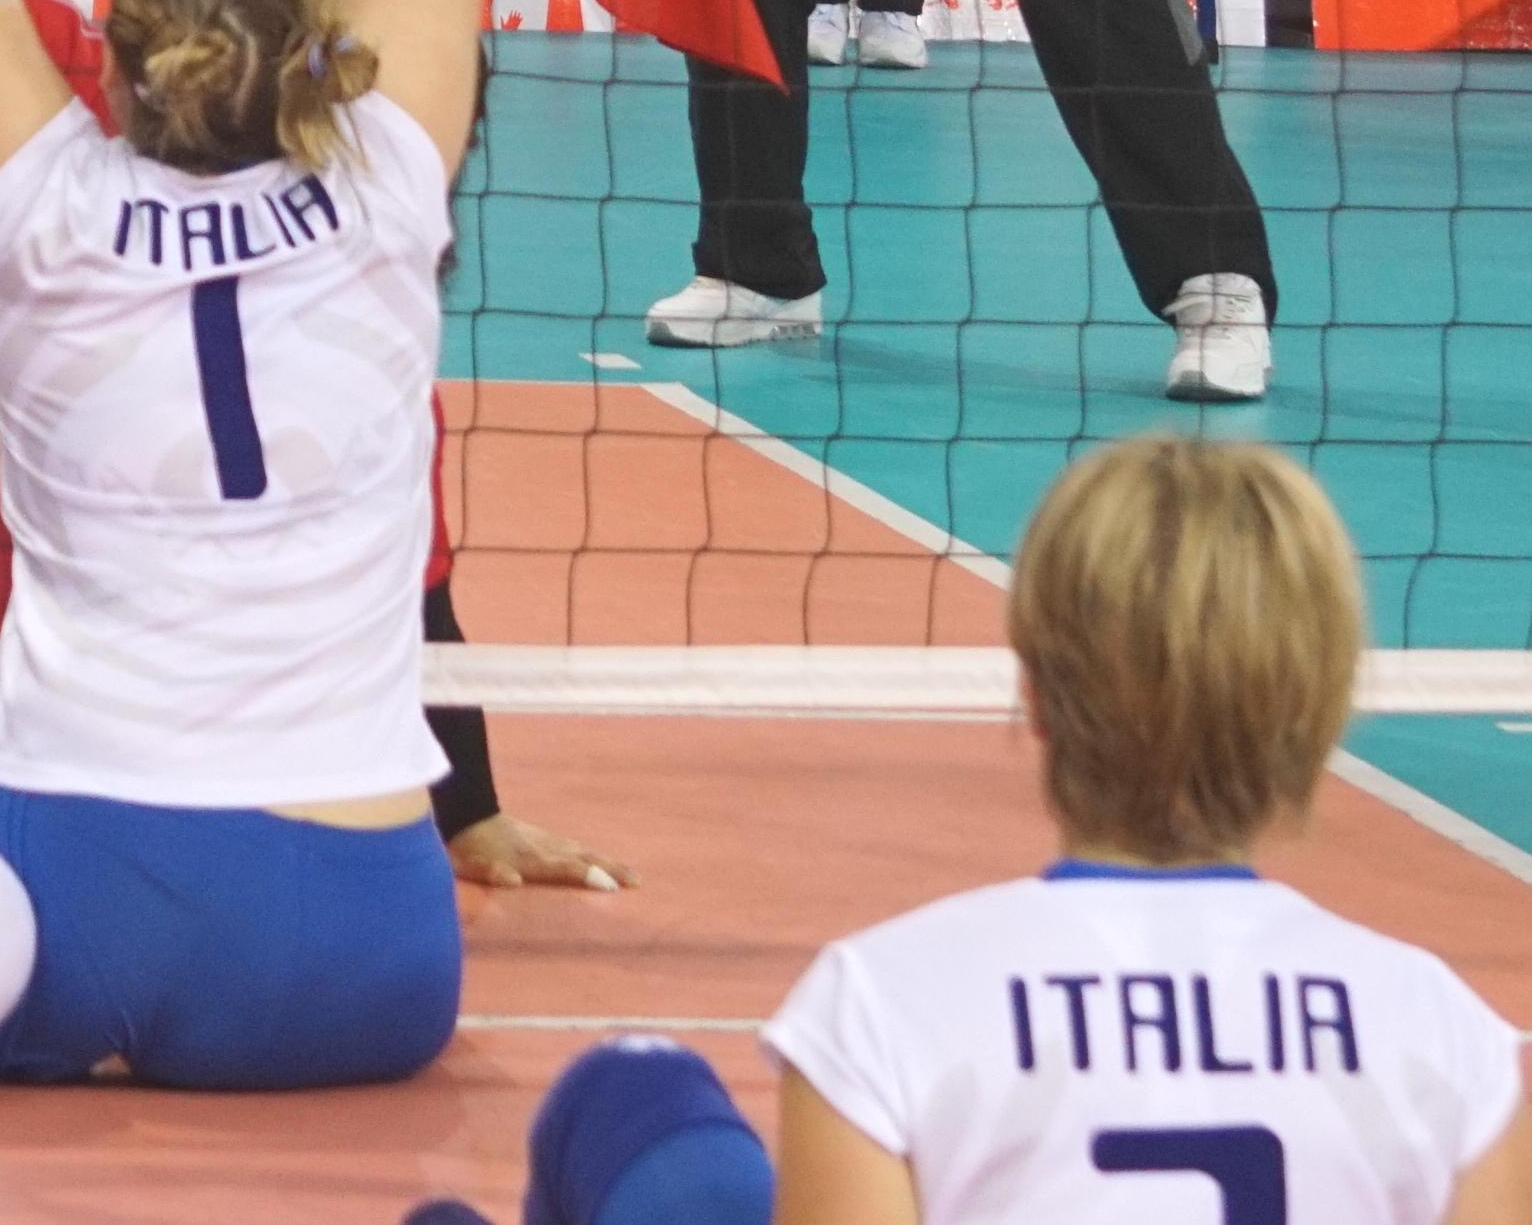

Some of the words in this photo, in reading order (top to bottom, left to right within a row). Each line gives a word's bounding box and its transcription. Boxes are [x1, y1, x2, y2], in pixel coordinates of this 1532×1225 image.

[113, 175, 339, 272] ITALIA
[191, 274, 268, 501] 1
[1009, 972, 1361, 1073] ITALIA
